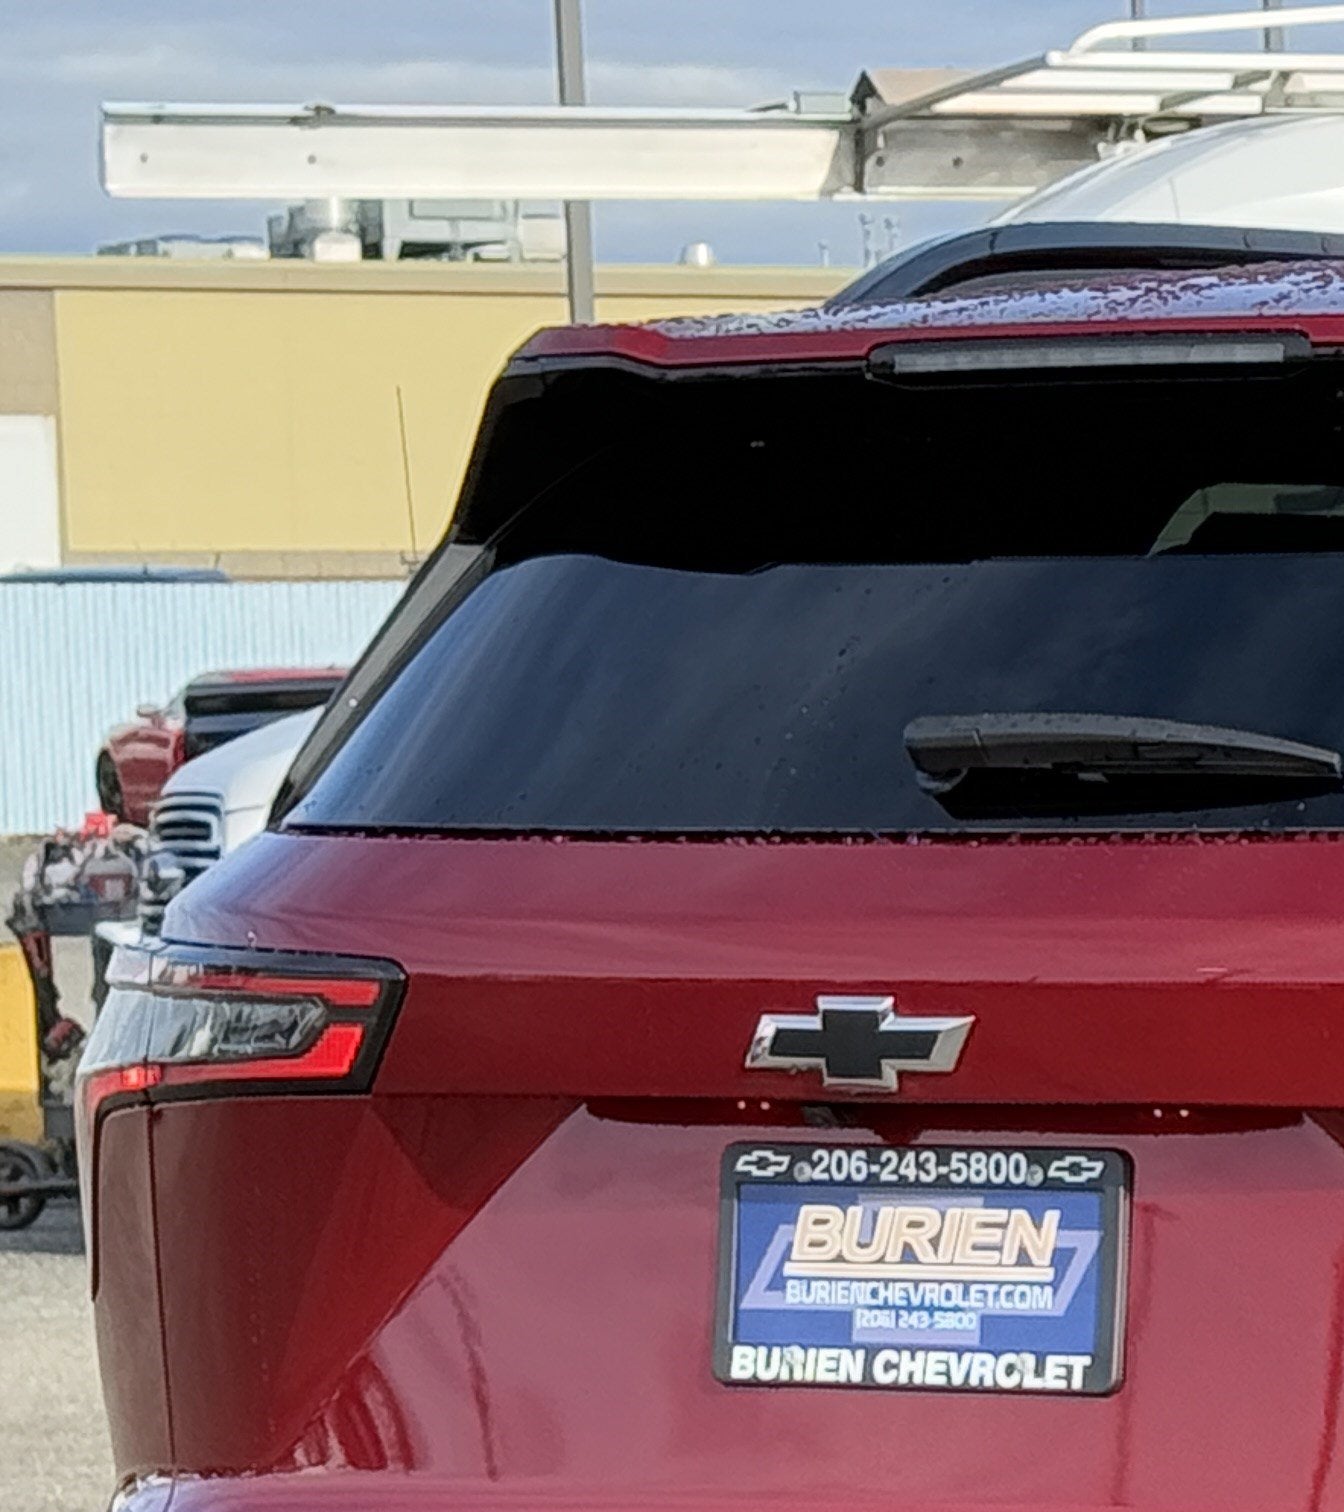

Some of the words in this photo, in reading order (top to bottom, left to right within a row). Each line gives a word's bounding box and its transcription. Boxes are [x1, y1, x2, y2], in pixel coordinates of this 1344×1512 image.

[811, 1149, 1027, 1184] 206-243-5800
[791, 1204, 1061, 1266] BURIEN
[785, 1279, 1054, 1310] BURIENCHEVROLET.COM
[730, 1344, 866, 1383] BURIEN
[872, 1348, 1092, 1390] CHEVROLET
